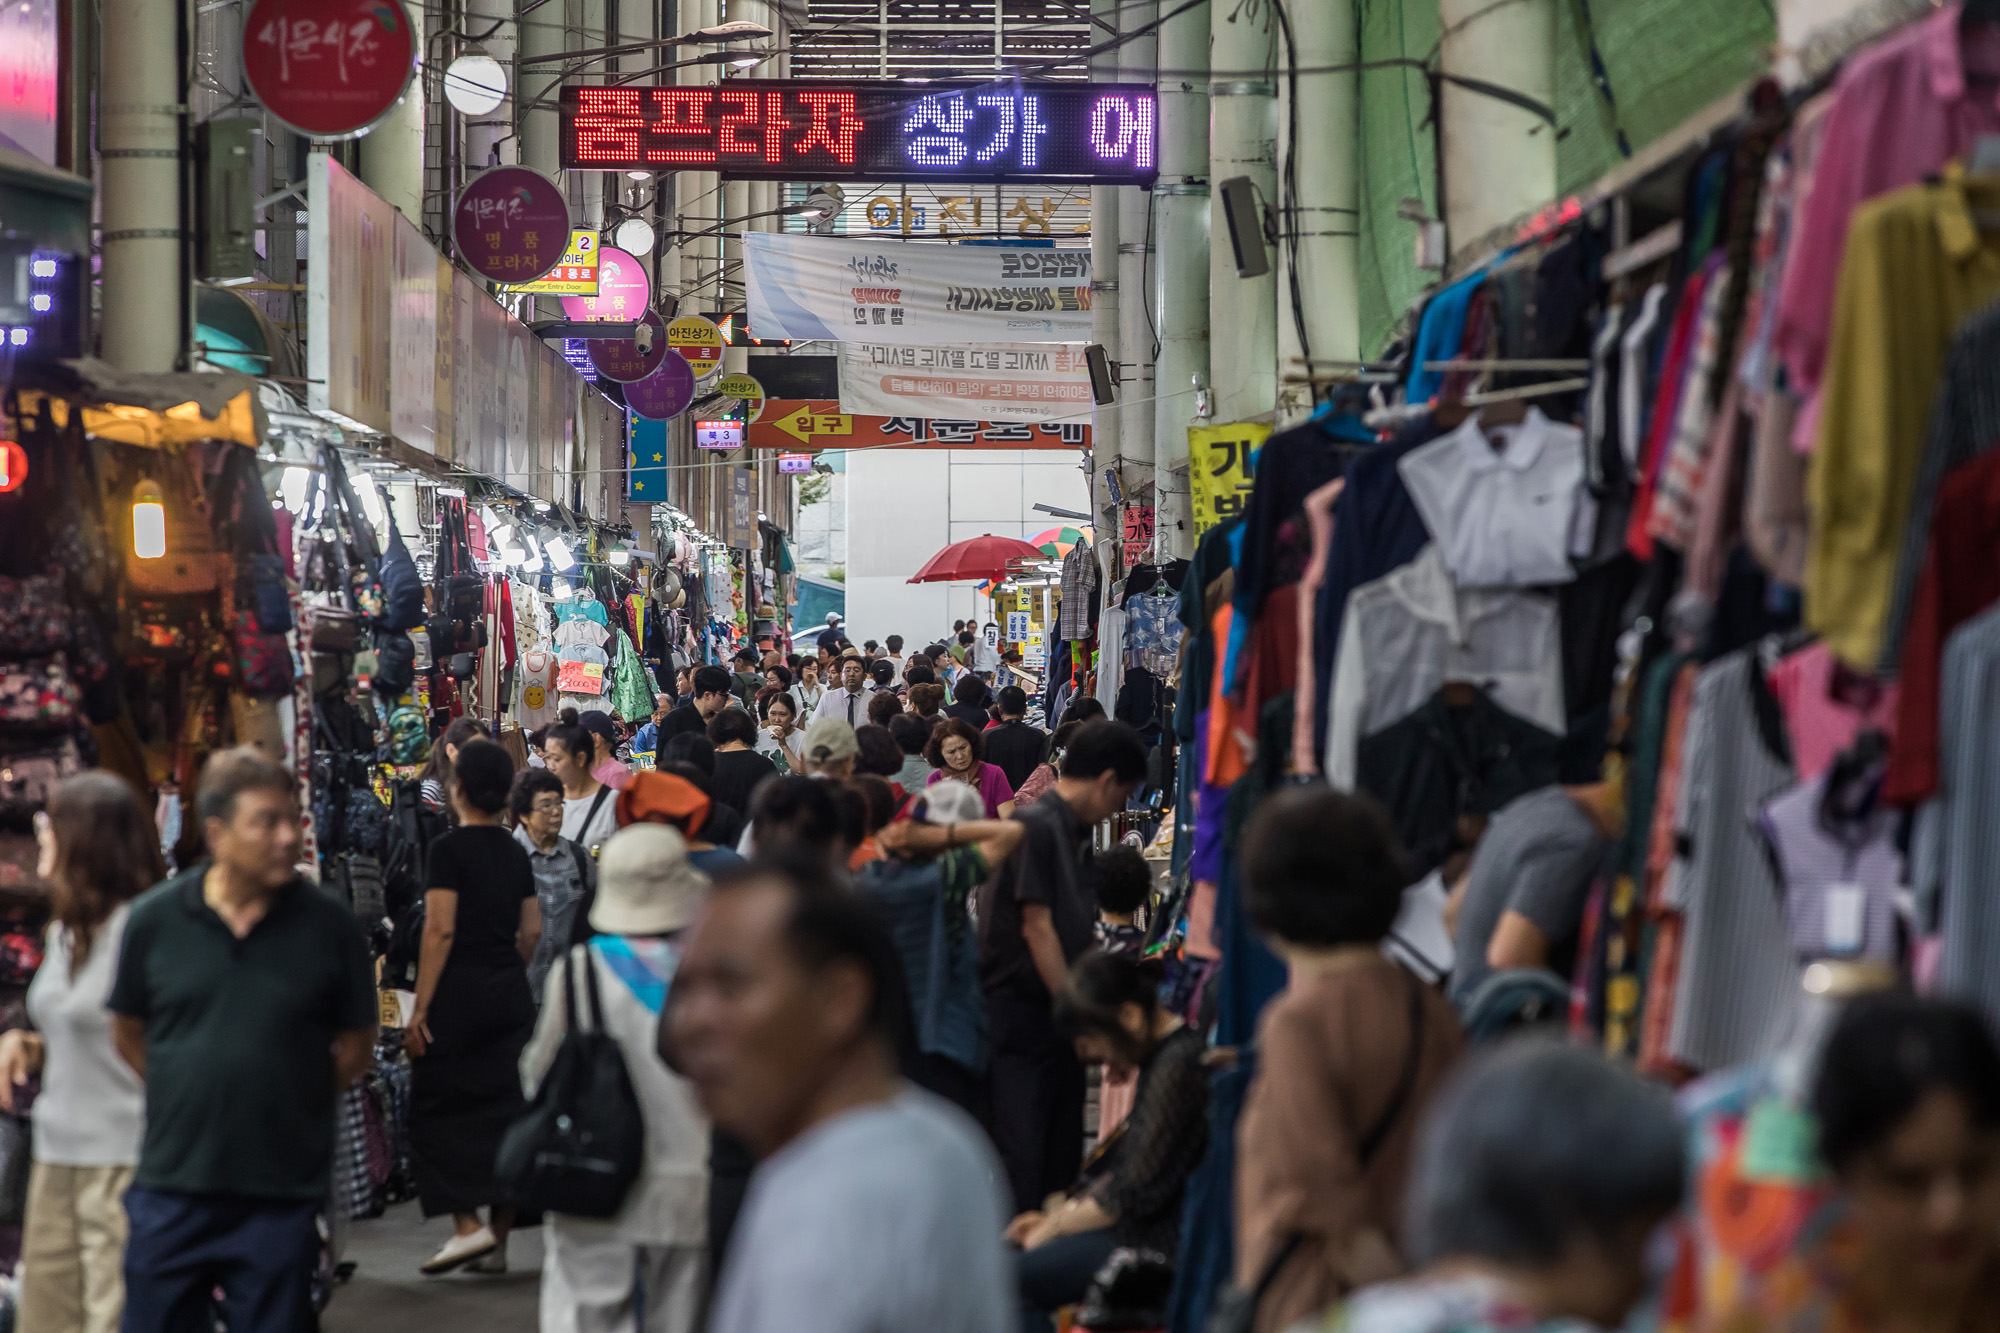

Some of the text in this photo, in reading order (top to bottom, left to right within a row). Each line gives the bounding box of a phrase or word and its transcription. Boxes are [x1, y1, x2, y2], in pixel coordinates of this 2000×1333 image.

[575, 89, 864, 164] 품프라자
[904, 95, 1047, 166] 상가
[580, 236, 590, 250] 2
[485, 254, 540, 271] 프라자
[669, 327, 714, 339] 아진상가
[720, 382, 756, 393] 아진상가
[708, 430, 730, 440] 북 3
